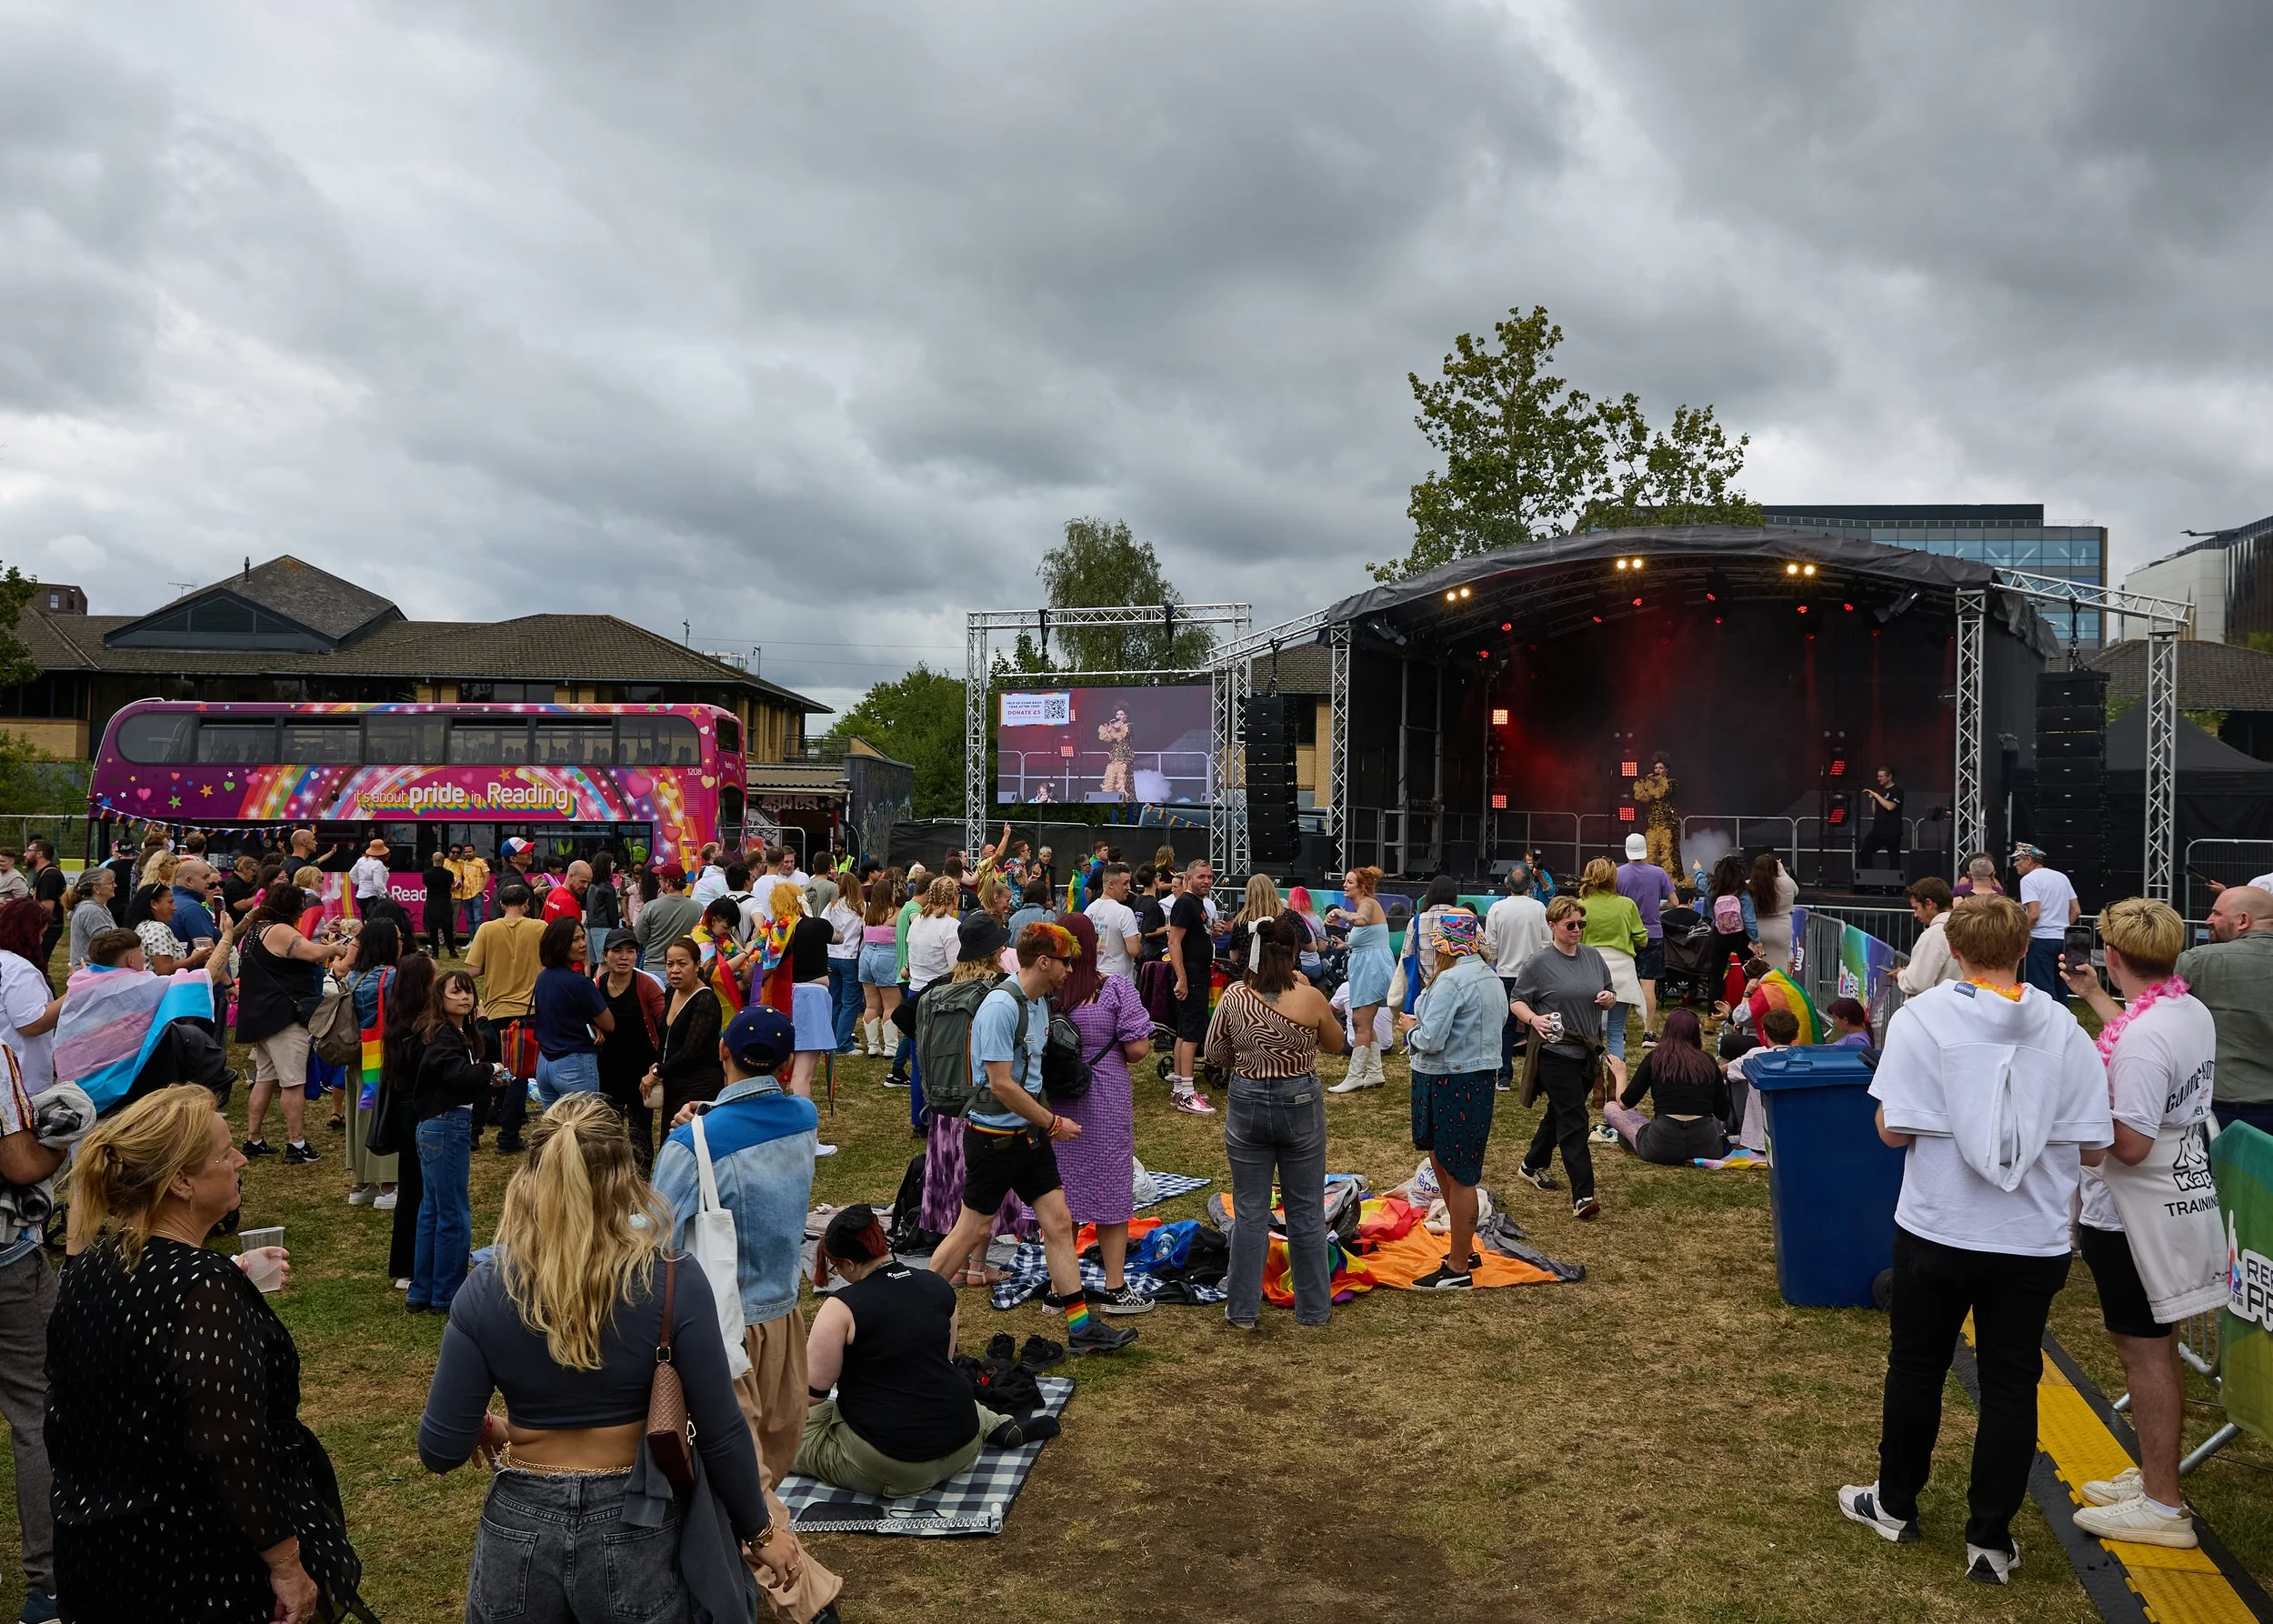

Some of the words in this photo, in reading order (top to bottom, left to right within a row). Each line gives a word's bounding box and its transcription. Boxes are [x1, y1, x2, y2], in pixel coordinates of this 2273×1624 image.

[686, 767, 703, 776] 1208
[354, 789, 370, 803] it's
[372, 789, 406, 803] about
[409, 781, 465, 809] pride
[471, 790, 481, 804] in
[487, 782, 568, 810] Reading
[391, 886, 427, 902] Read
[2173, 1168, 2212, 1192] Kap
